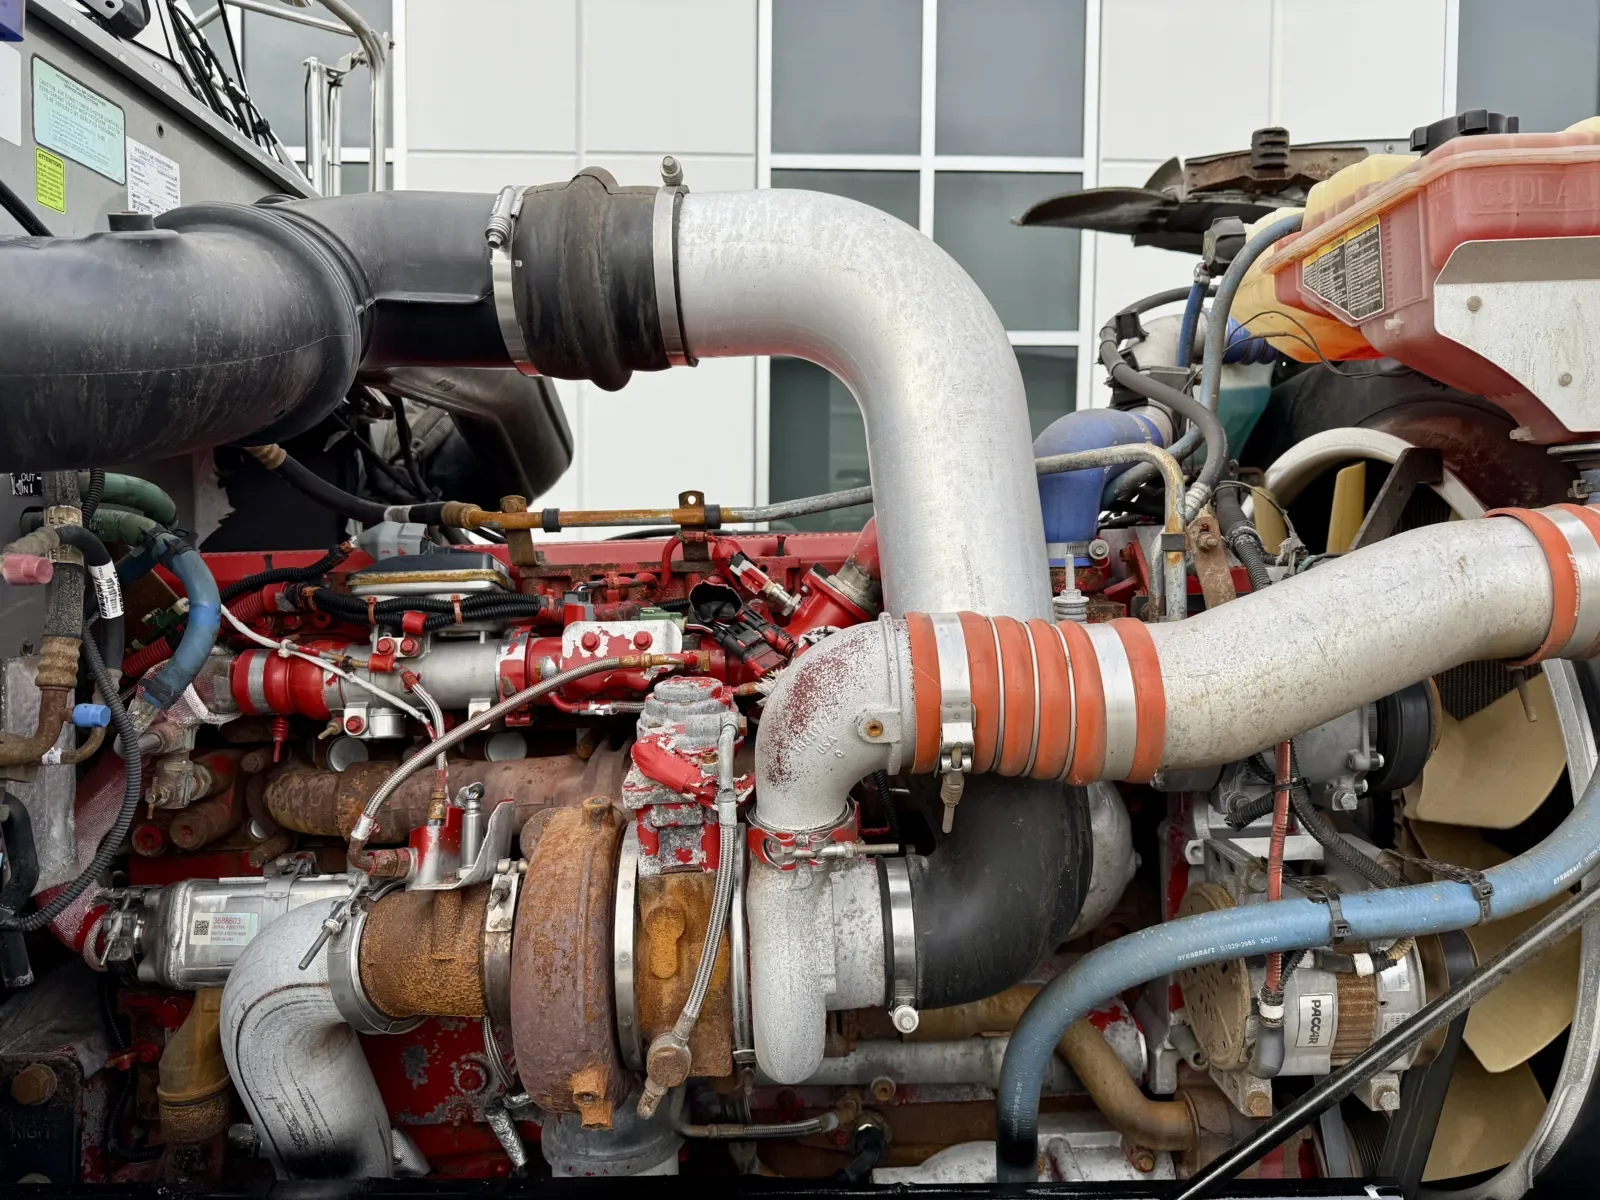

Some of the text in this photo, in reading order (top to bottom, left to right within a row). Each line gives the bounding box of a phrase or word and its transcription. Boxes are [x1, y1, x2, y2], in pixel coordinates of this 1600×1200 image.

[38, 153, 62, 168] ATTENTION
[21, 472, 35, 482] OUT
[816, 736, 837, 754] USA
[1308, 1000, 1321, 1044] PACCAR
